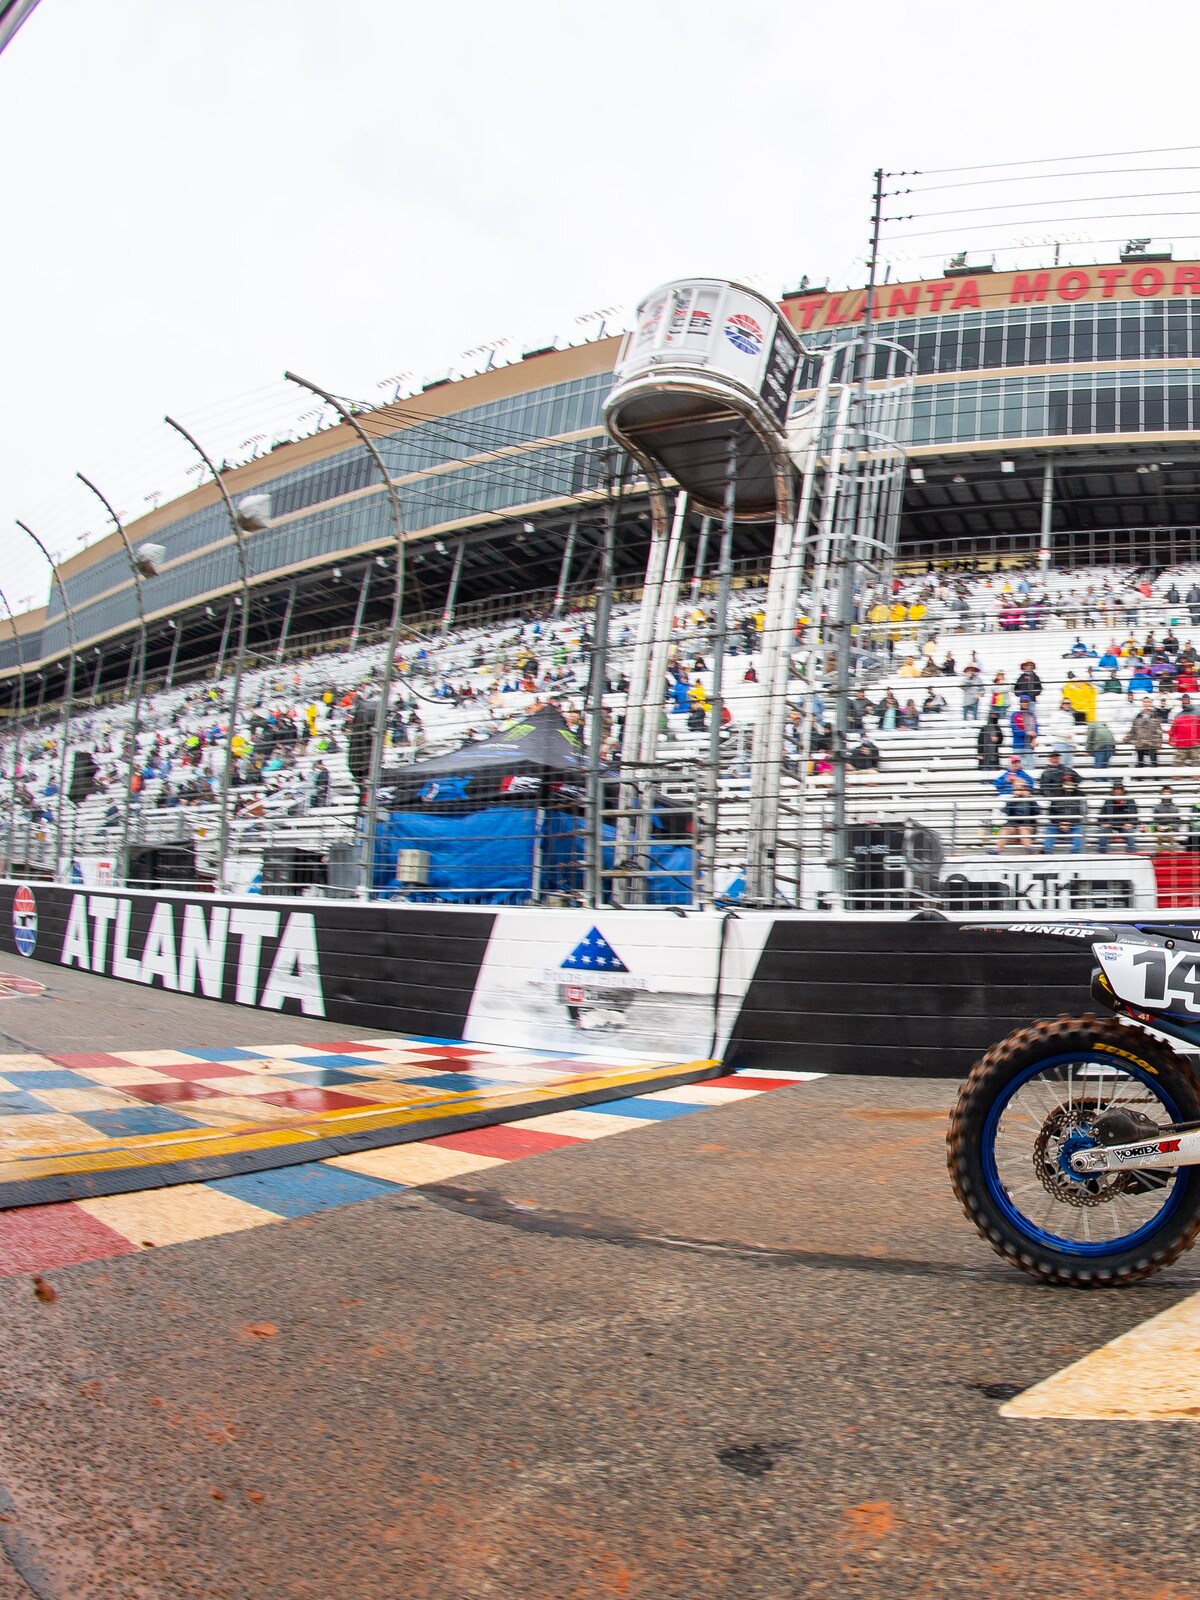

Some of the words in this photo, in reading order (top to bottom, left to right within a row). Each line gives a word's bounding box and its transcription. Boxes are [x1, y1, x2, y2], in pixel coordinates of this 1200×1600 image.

[1008, 923, 1095, 939] DUNLOP
[60, 893, 326, 1017] ATLANTA
[1092, 1042, 1159, 1075] DUNLOP
[1113, 1143, 1159, 1162] VORTEX
[1158, 1138, 1181, 1153] EK
